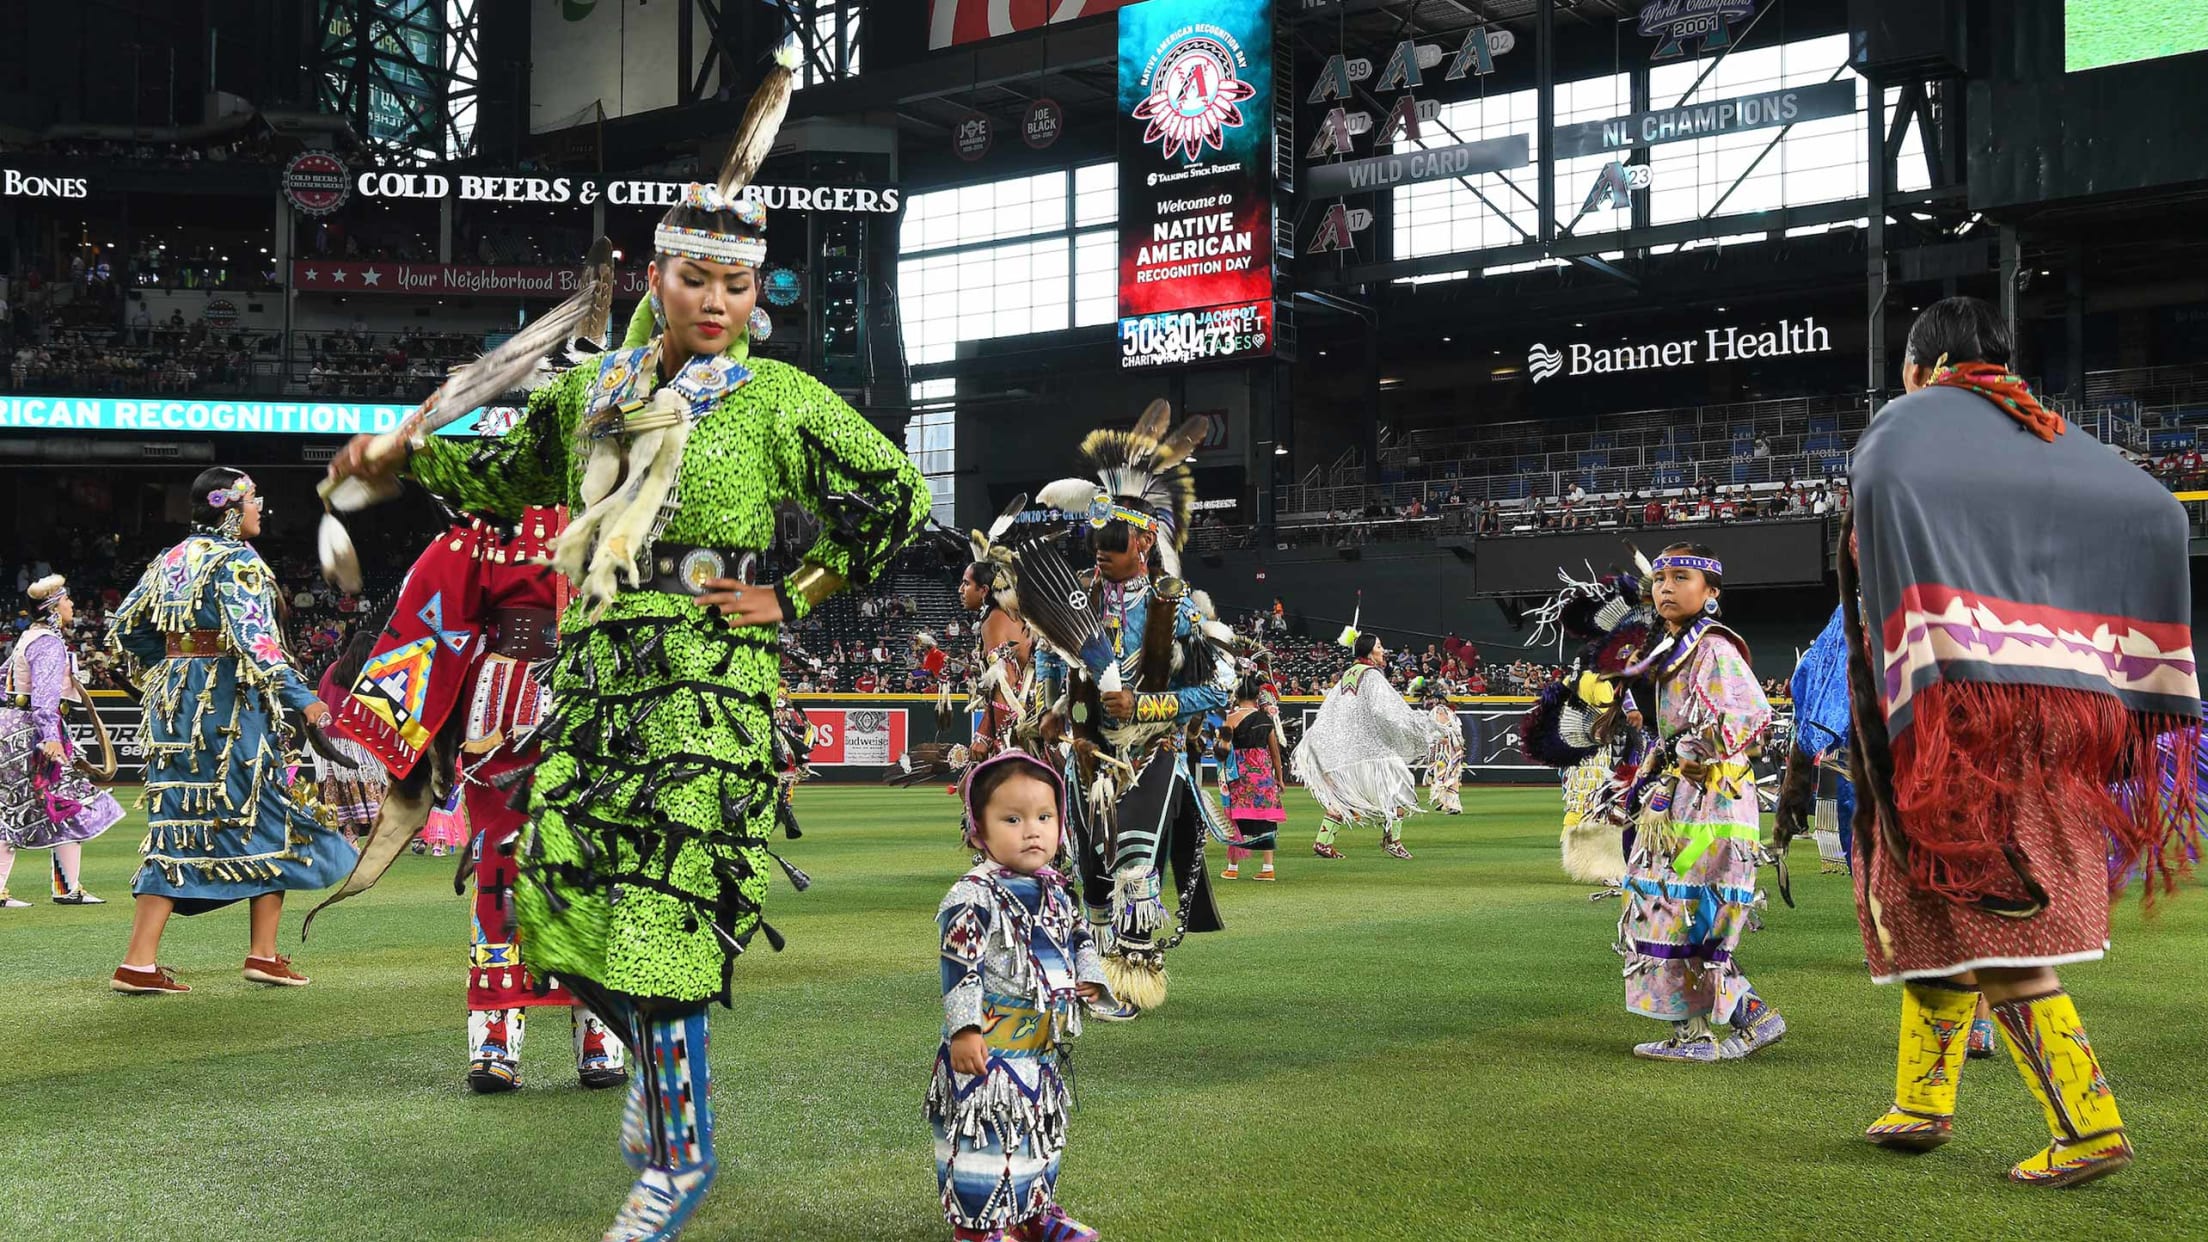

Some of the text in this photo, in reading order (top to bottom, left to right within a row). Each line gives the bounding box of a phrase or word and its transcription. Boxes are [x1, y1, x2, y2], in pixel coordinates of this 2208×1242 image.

[1673, 15, 1720, 38] 2001
[1140, 24, 1248, 86] NATIVE AMERICAN RECOGNITION DAY
[1349, 61, 1367, 77] 99
[1034, 108, 1050, 121] JOE
[1419, 102, 1435, 118] 11
[1603, 93, 1799, 148] NL CHAMPIONS
[1027, 118, 1057, 134] BLACK
[1349, 115, 1367, 131] 07
[1158, 172, 1189, 183] TALKING
[1349, 148, 1470, 189] WILD CARD
[1628, 168, 1650, 186] 23
[358, 172, 449, 198] COLD
[459, 175, 571, 203] BEERS
[579, 181, 601, 205] &
[1156, 194, 1232, 215] Welcome to
[1153, 212, 1234, 242] NATIVE
[1352, 212, 1365, 229] 17
[1136, 232, 1252, 267] AMERICAN
[397, 266, 437, 288] Your
[443, 268, 553, 292] Neighborhood
[1136, 255, 1252, 283] RECOGNITION DAY
[1196, 305, 1258, 325] JACKPOT
[1568, 316, 1832, 376] Banner Health
[114, 402, 361, 432] RECOGNITION
